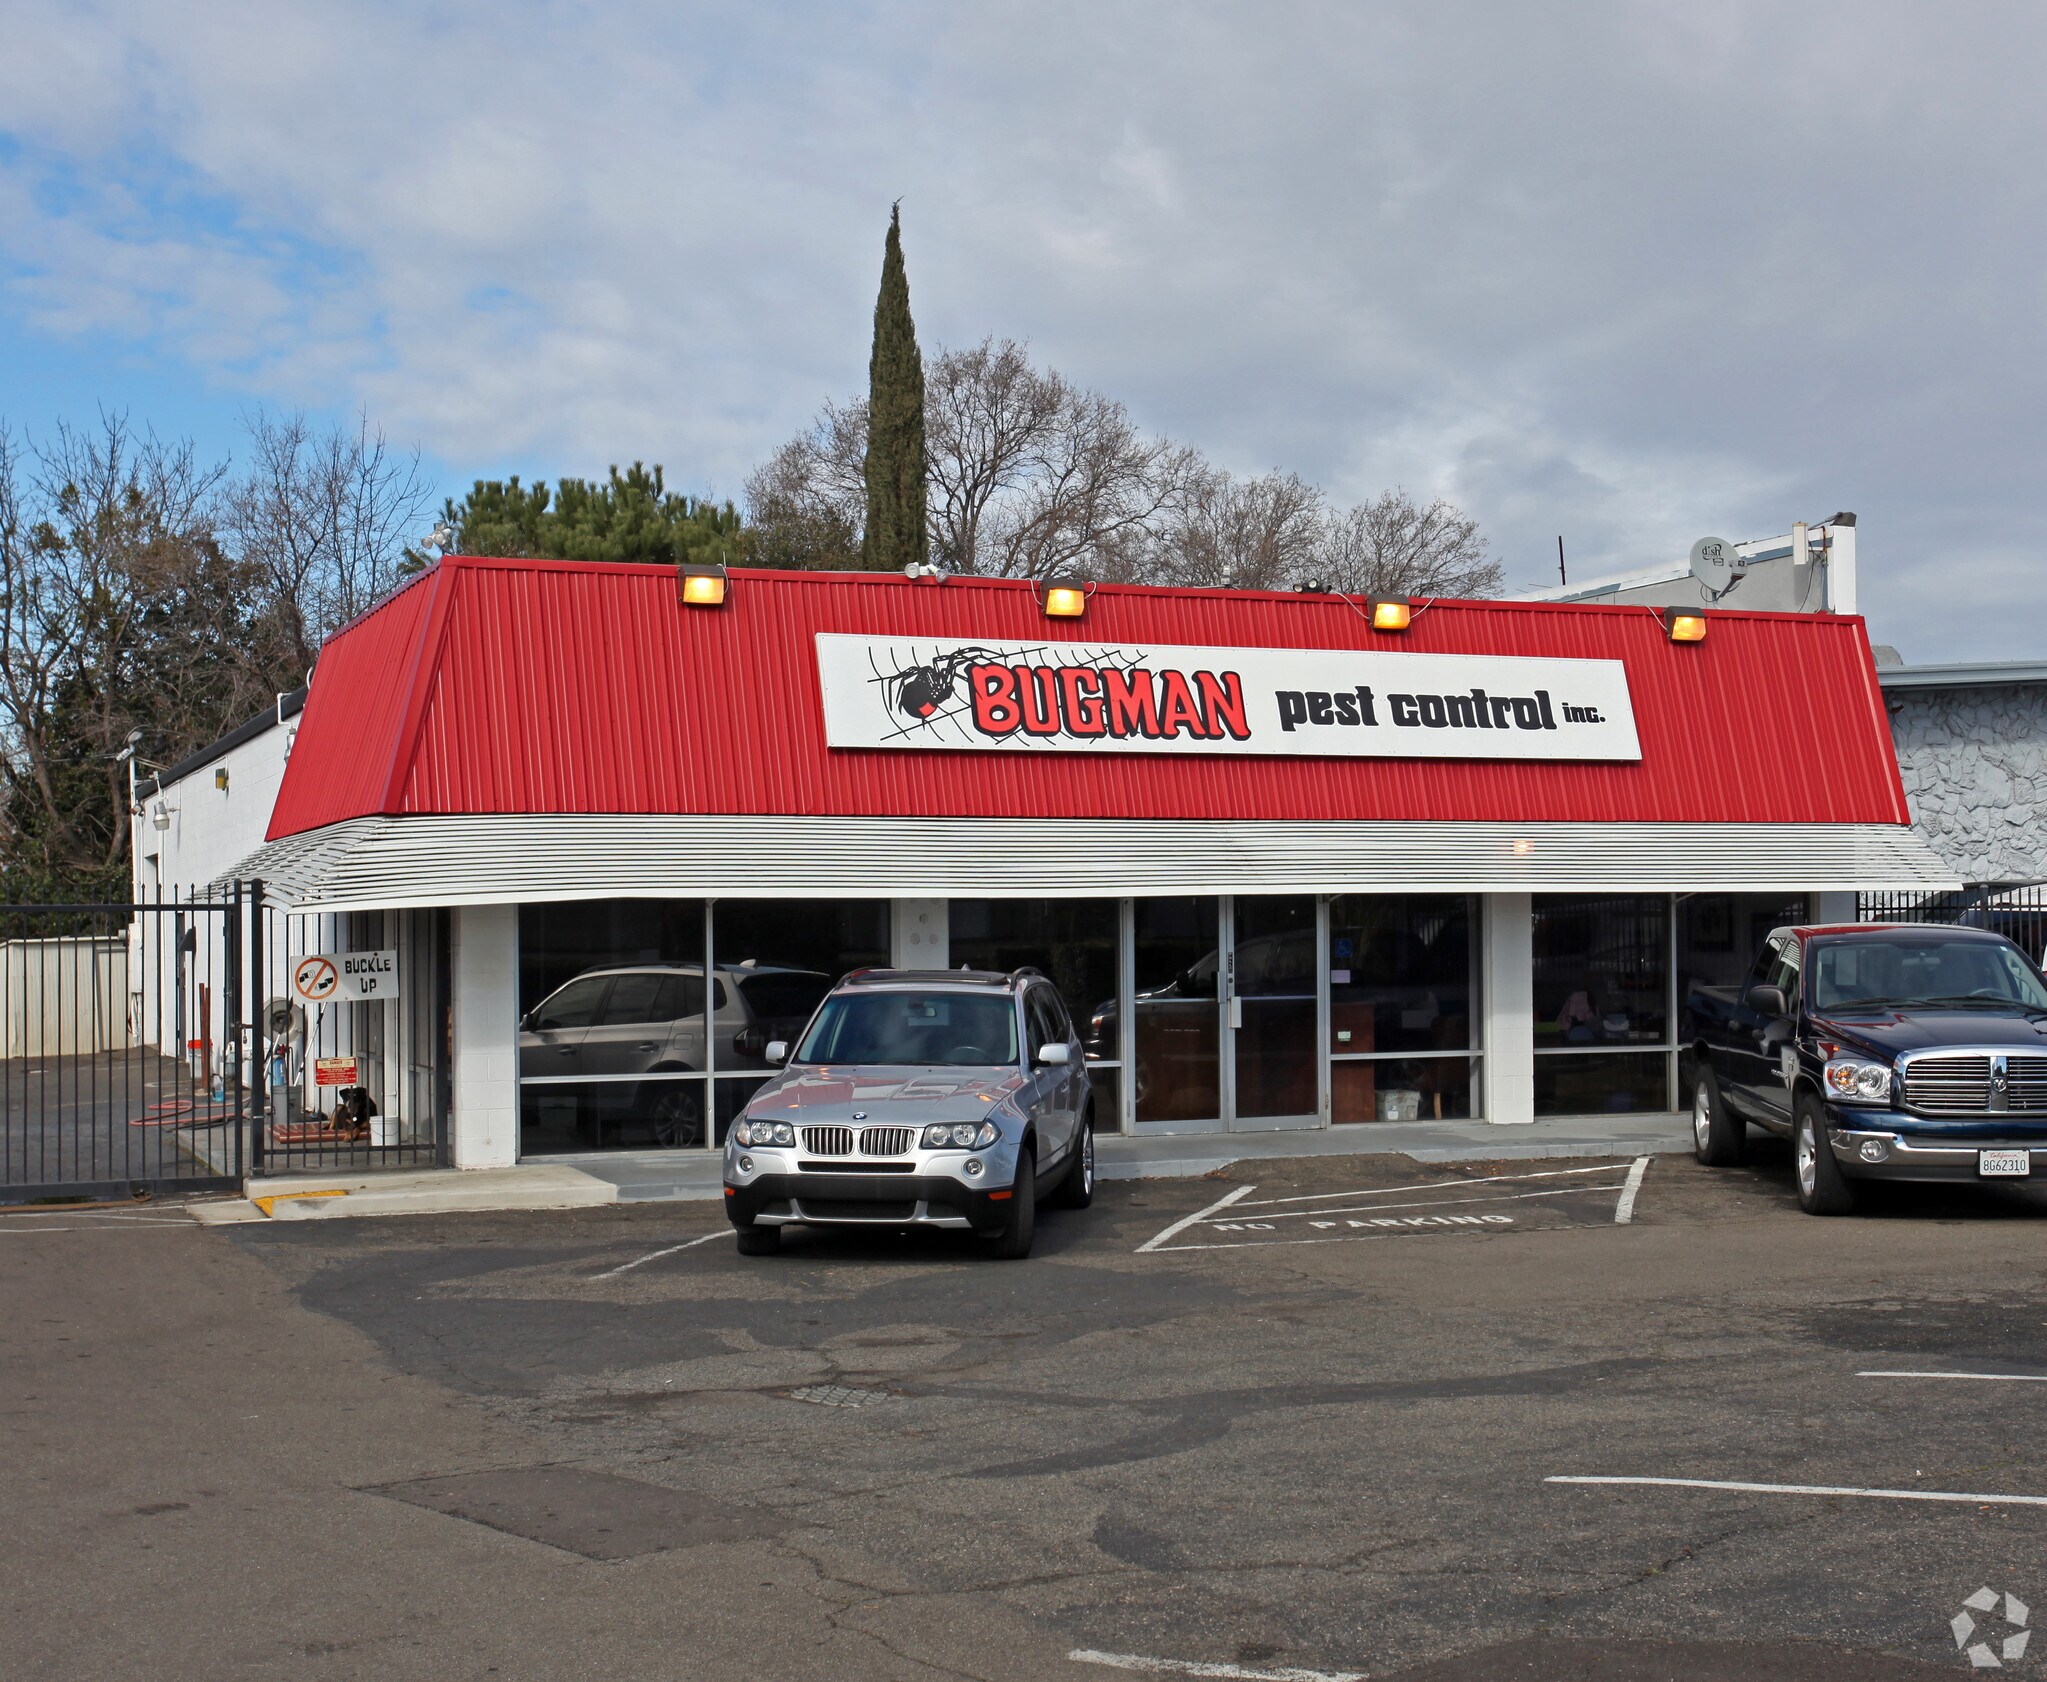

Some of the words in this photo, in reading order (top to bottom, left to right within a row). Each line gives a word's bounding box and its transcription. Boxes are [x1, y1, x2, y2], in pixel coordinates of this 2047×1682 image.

[965, 664, 1252, 741] BUGMAN
[1275, 686, 1379, 731] pest
[1387, 689, 1557, 730] control
[1562, 702, 1606, 723] inc.
[345, 958, 391, 974] BUCKLE
[360, 977, 377, 993] UP
[1983, 1159, 2026, 1171] 8G62310
[1212, 1223, 1276, 1232] NO
[1308, 1214, 1514, 1229] PARKING
